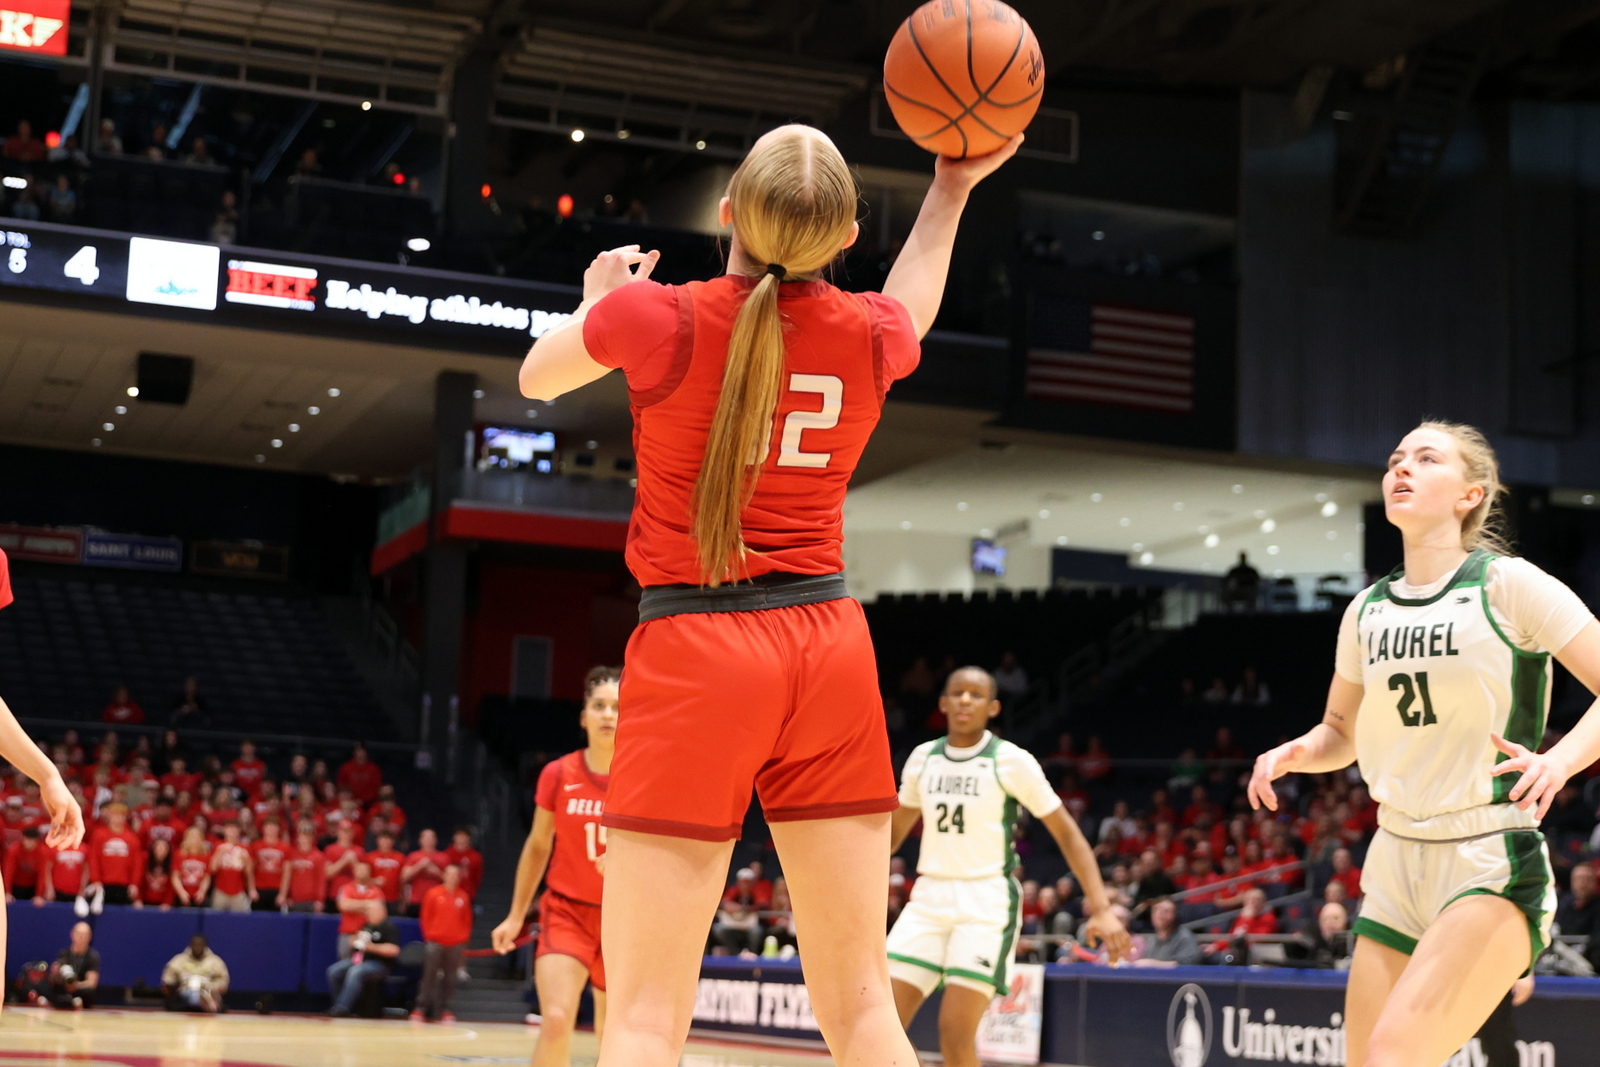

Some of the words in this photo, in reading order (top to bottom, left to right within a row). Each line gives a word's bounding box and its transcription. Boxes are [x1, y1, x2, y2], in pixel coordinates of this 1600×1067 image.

[64, 246, 99, 285] 4
[325, 279, 429, 324] Helping
[430, 295, 529, 330] athletes
[133, 546, 178, 562] LOUIS
[1368, 622, 1460, 665] LAUREL
[1387, 671, 1437, 727] 21
[927, 775, 981, 797] LAUREL
[936, 802, 965, 834] 24
